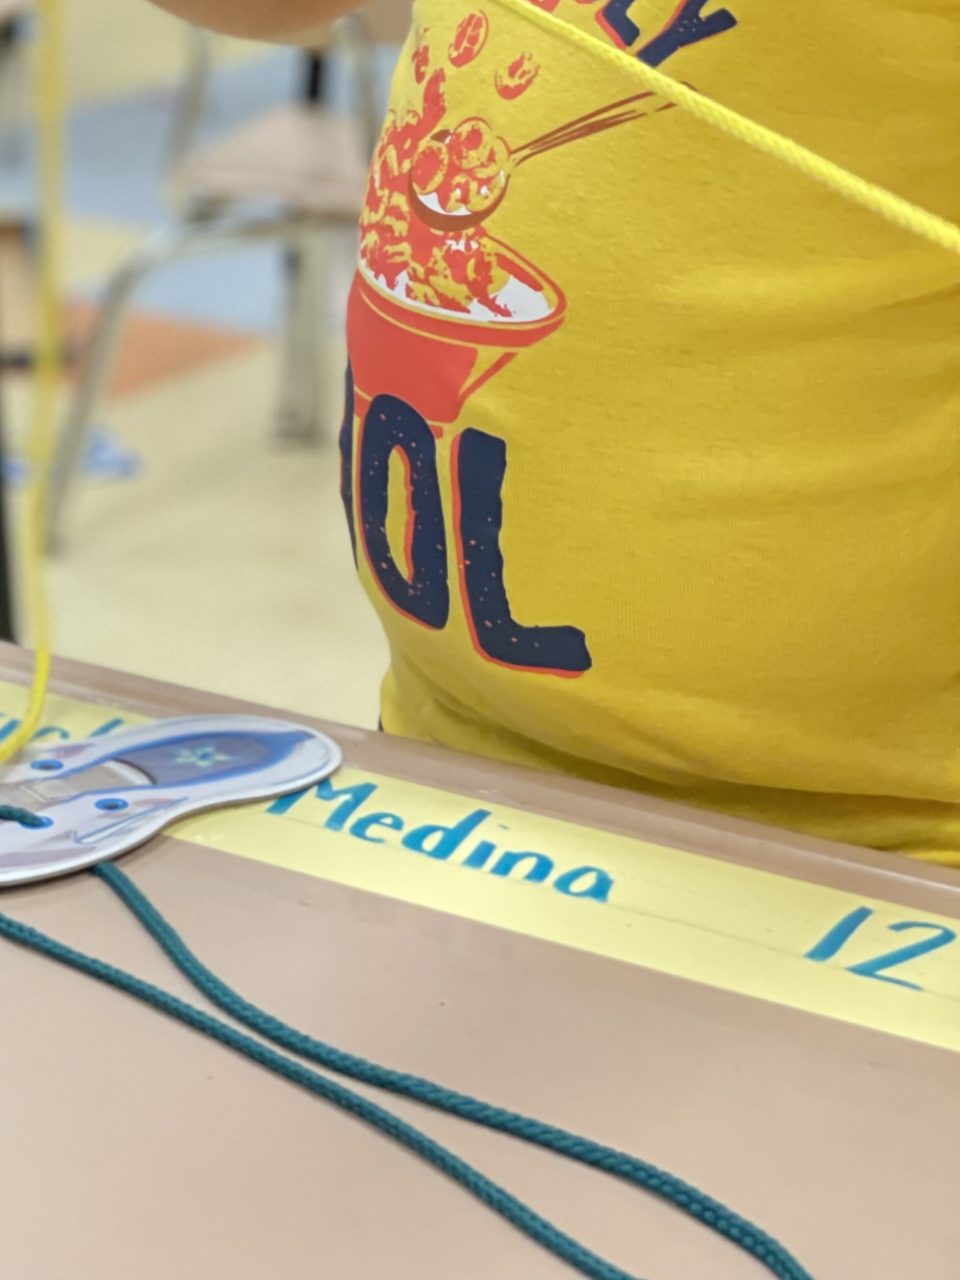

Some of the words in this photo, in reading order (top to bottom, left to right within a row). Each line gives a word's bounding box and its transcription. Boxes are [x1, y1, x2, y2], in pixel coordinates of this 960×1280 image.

[339, 358, 593, 678] OL
[266, 777, 615, 903] Medina
[803, 905, 957, 992] 12
